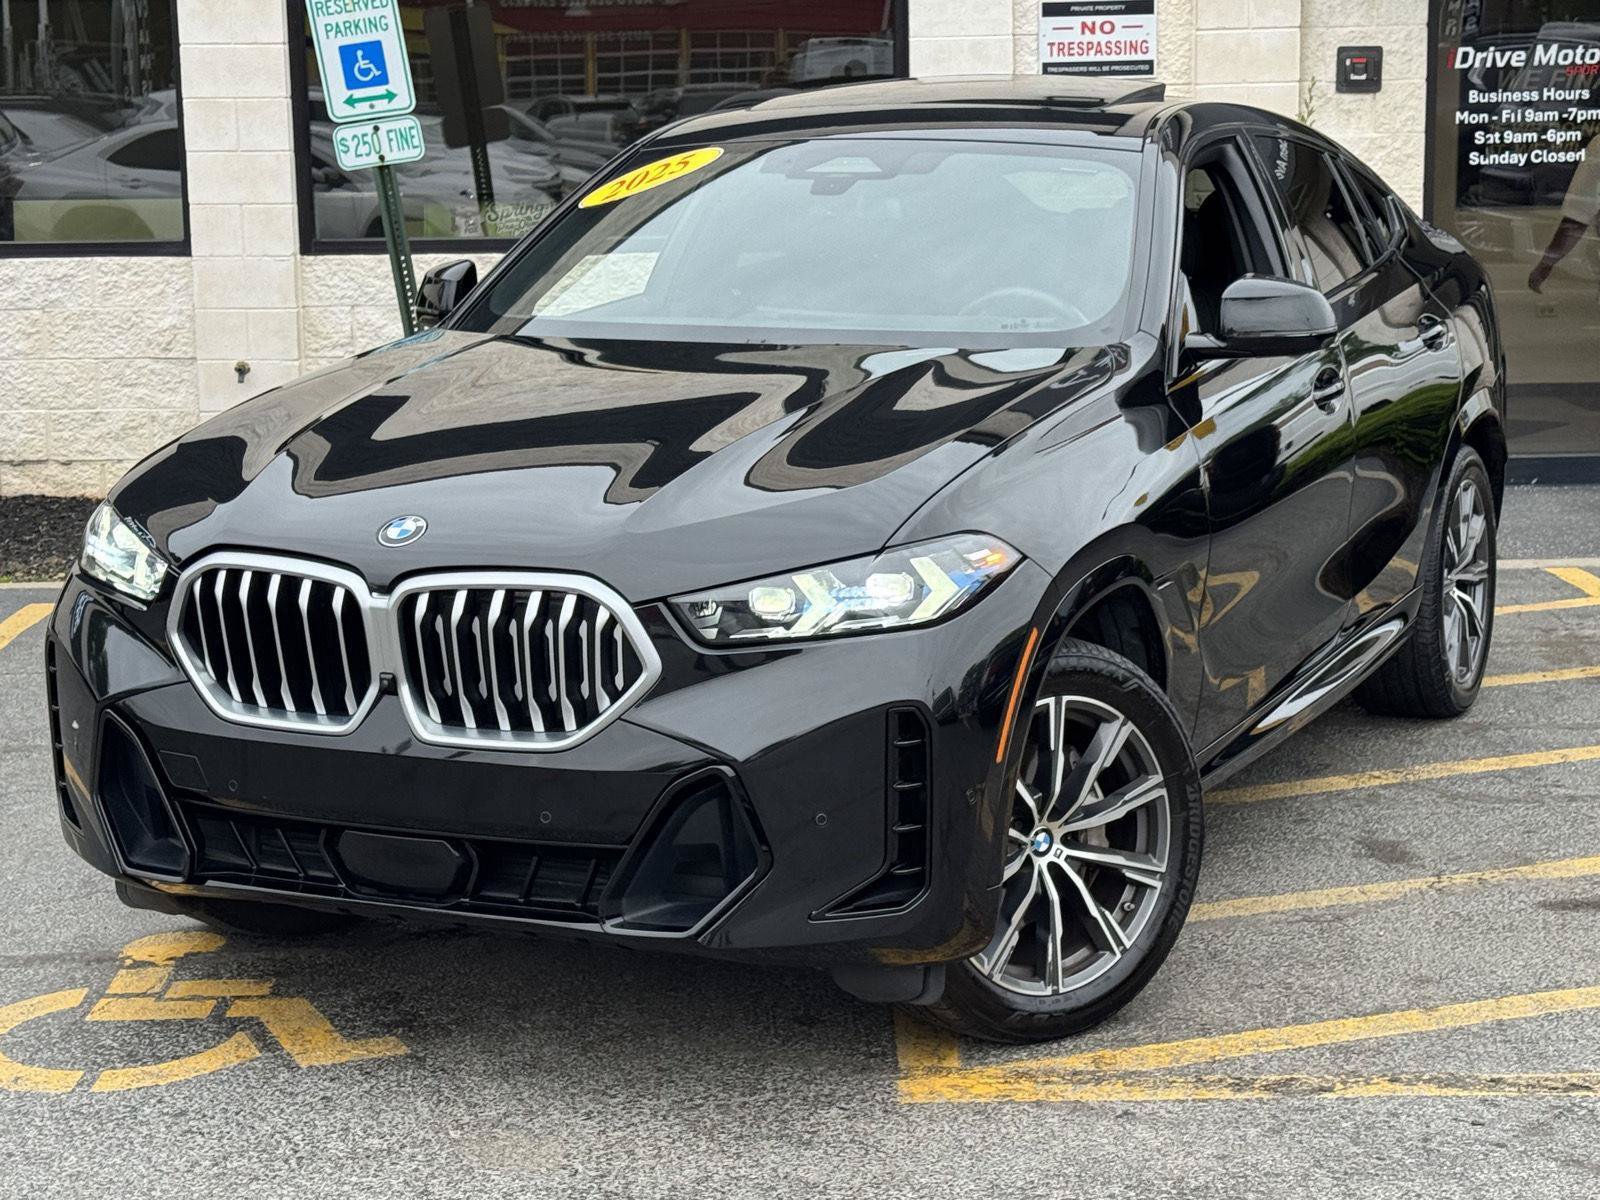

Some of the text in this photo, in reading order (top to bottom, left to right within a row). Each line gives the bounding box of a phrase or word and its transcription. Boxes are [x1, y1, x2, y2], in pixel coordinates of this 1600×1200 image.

[315, 0, 389, 17] RESERVED
[324, 15, 389, 39] PARKING
[1080, 20, 1115, 35] NO
[1047, 39, 1149, 57] TRESPASSING
[1468, 87, 1591, 103] Business Hours
[1455, 110, 1489, 125] Mon
[1524, 109, 1559, 123] 9am
[338, 126, 420, 158] $250 FINE
[1474, 130, 1501, 145] Sat
[1503, 130, 1538, 144] 9am
[1468, 148, 1586, 167] Sunday Closed
[601, 153, 697, 201] 2025
[1168, 783, 1201, 933] BRIDGESTONE
